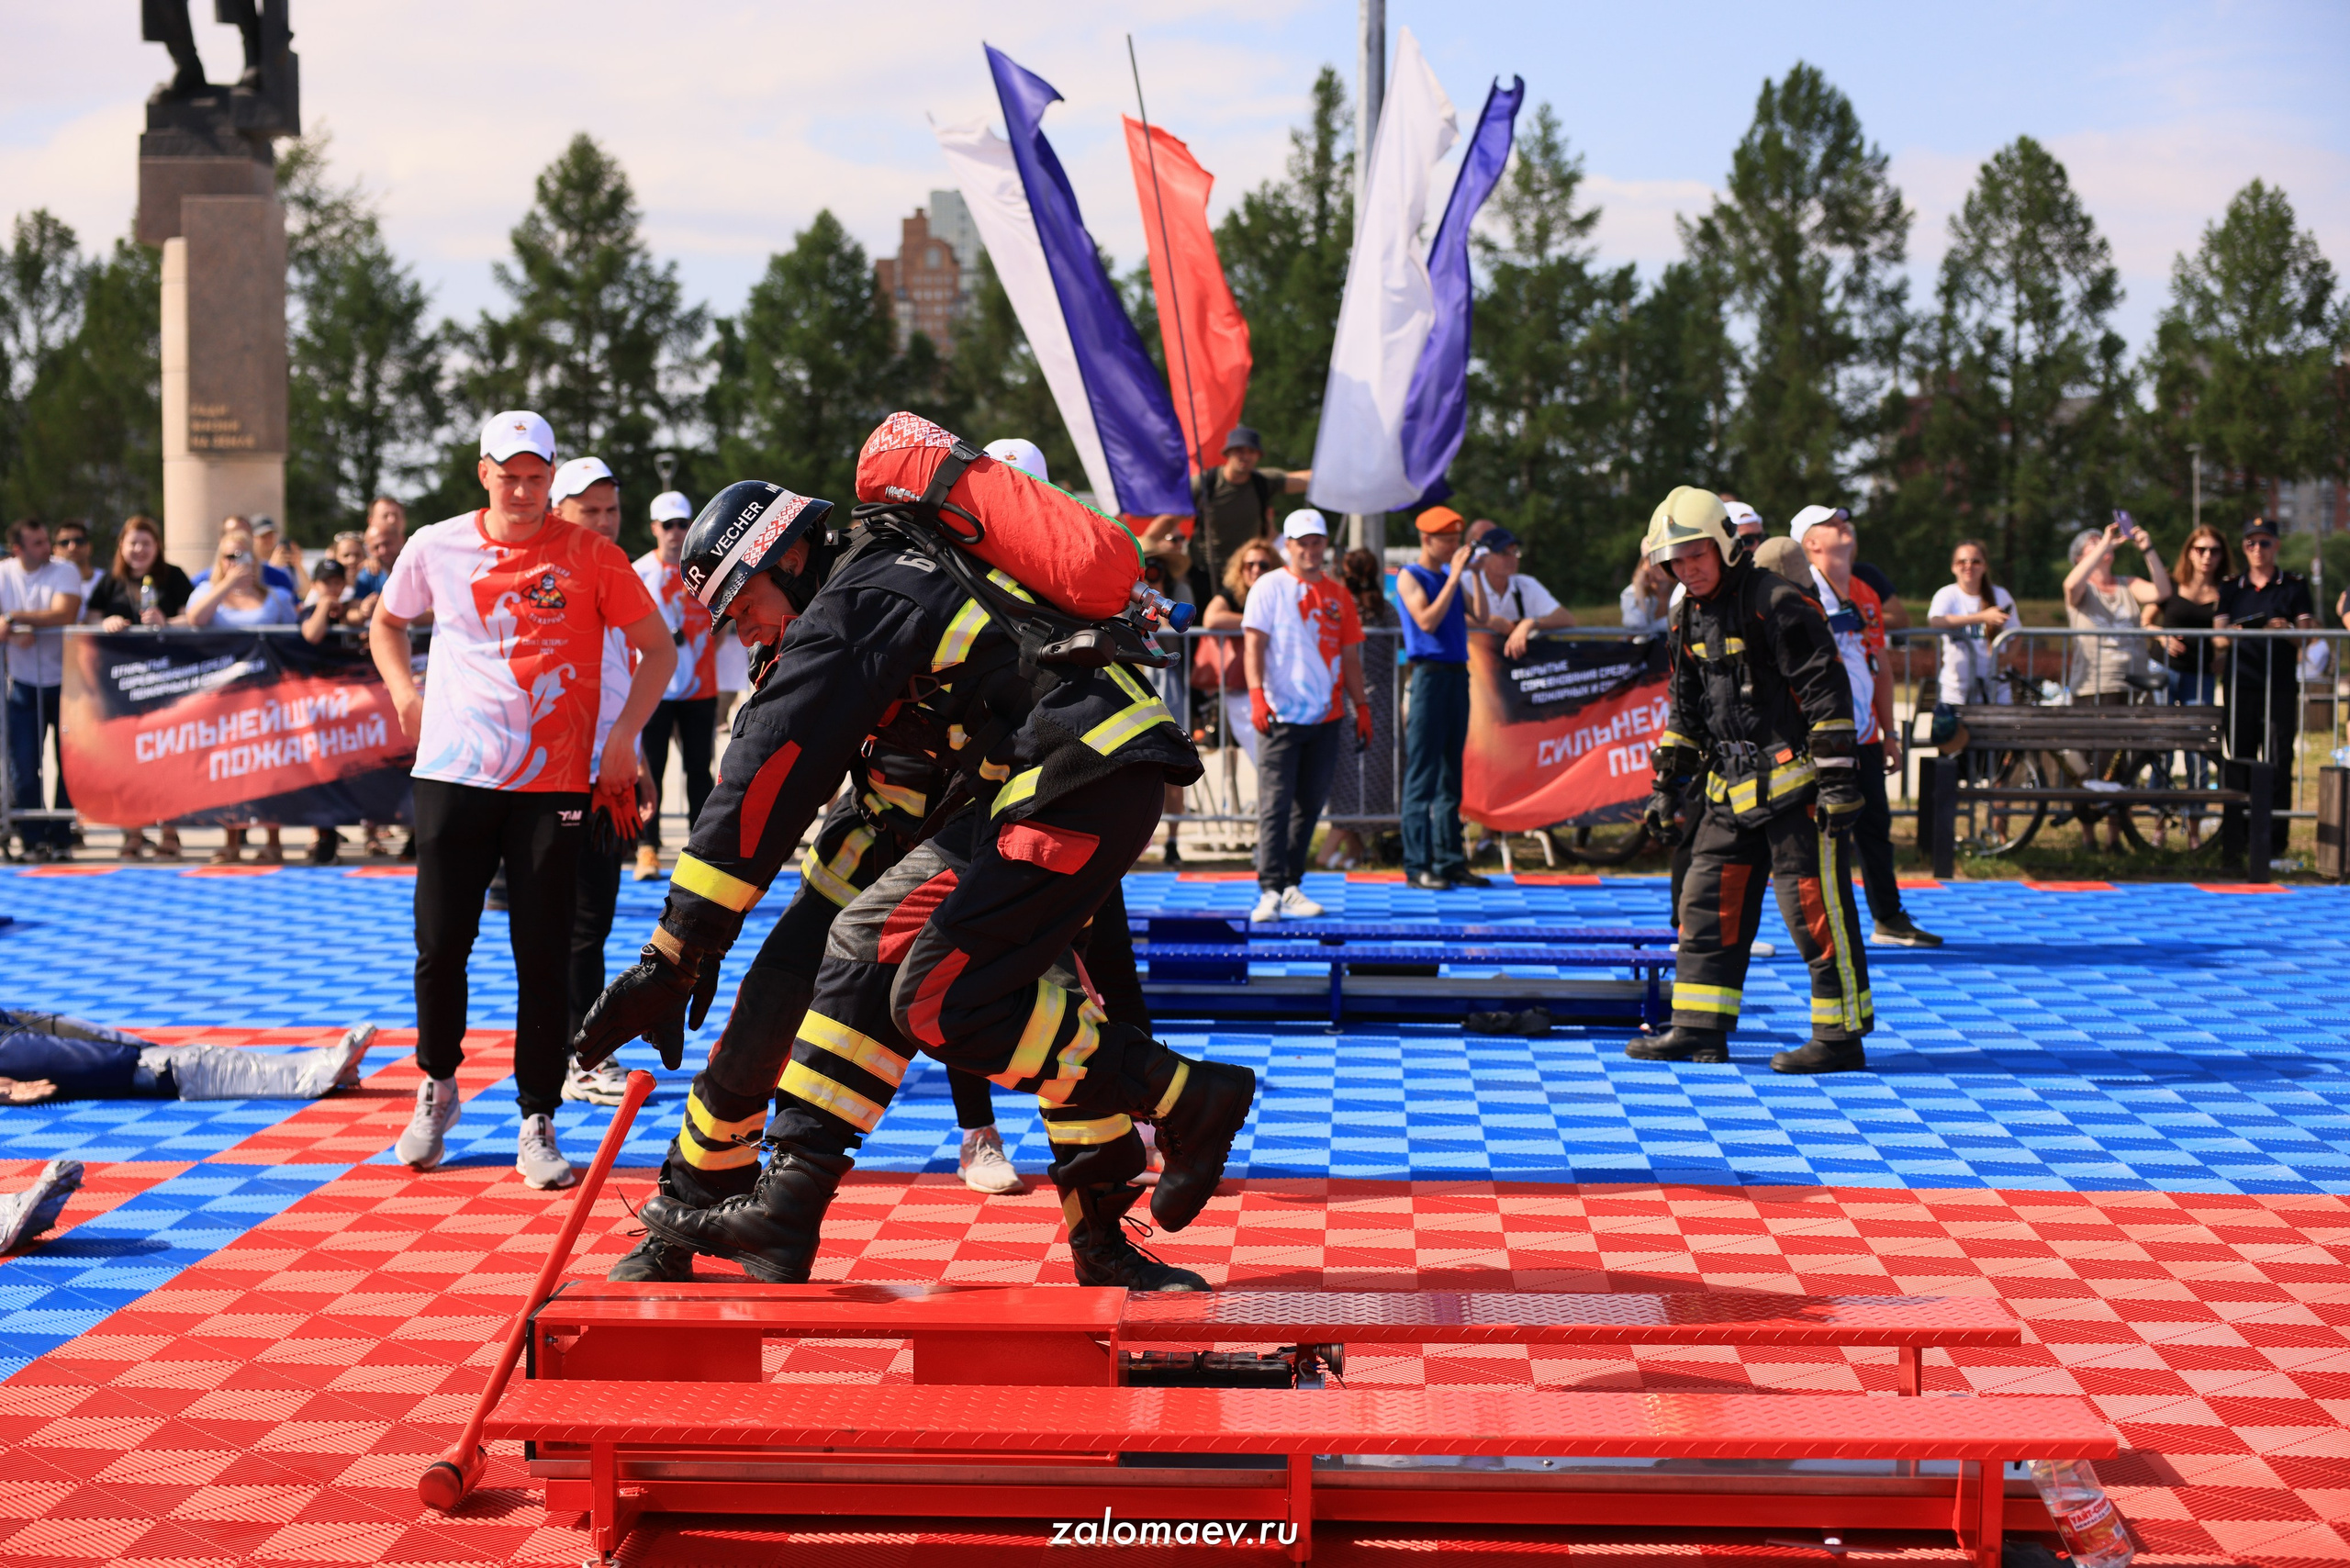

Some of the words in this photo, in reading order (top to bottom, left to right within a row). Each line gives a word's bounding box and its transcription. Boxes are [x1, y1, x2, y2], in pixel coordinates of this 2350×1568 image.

[711, 501, 764, 557] VECHER
[135, 687, 351, 764] СИЛЬНЕЙШИЙ
[209, 712, 387, 781] ПОЖАРНЫЙ
[1537, 696, 1671, 768] СИЛЬНЕЙ
